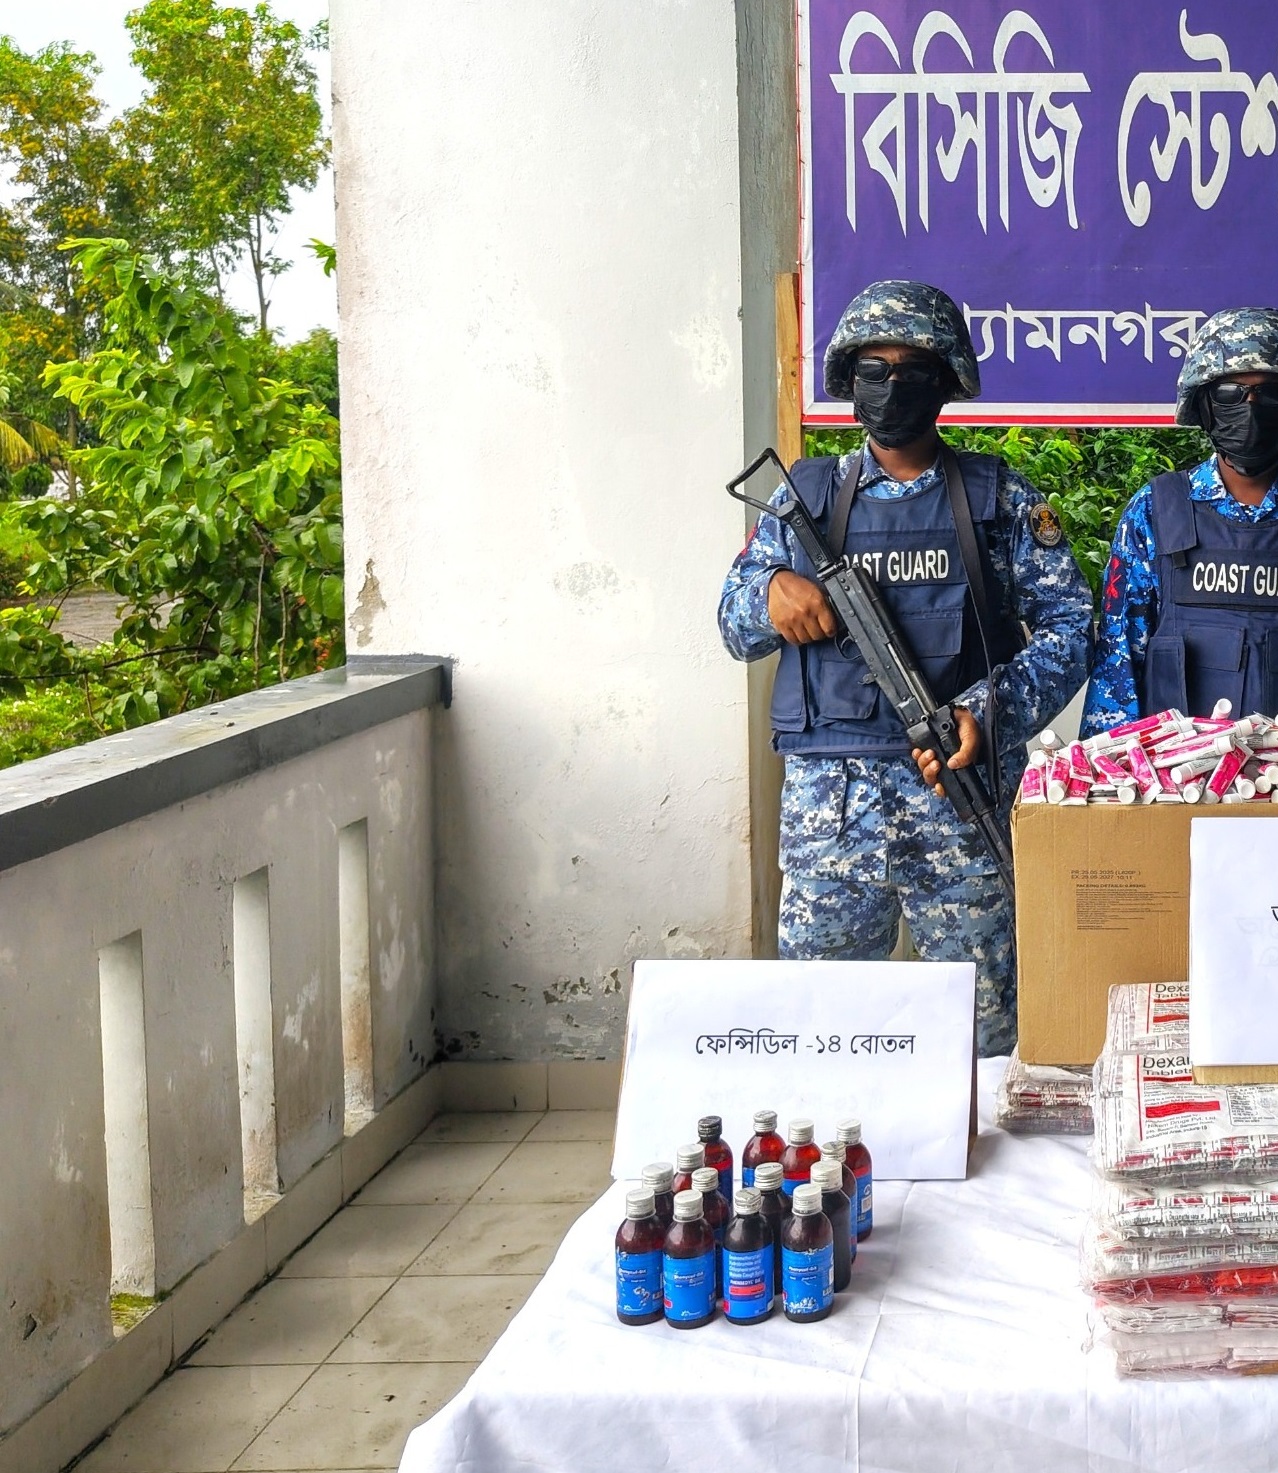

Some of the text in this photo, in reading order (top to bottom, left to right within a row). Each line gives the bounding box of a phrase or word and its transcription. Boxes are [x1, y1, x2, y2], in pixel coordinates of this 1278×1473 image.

[829, 10, 1091, 237] বিসিজি
[887, 550, 949, 581] GUARD
[1192, 562, 1250, 593] COAST
[696, 1028, 799, 1054] ফেন্সিডিল
[851, 1035, 916, 1054] বোতল
